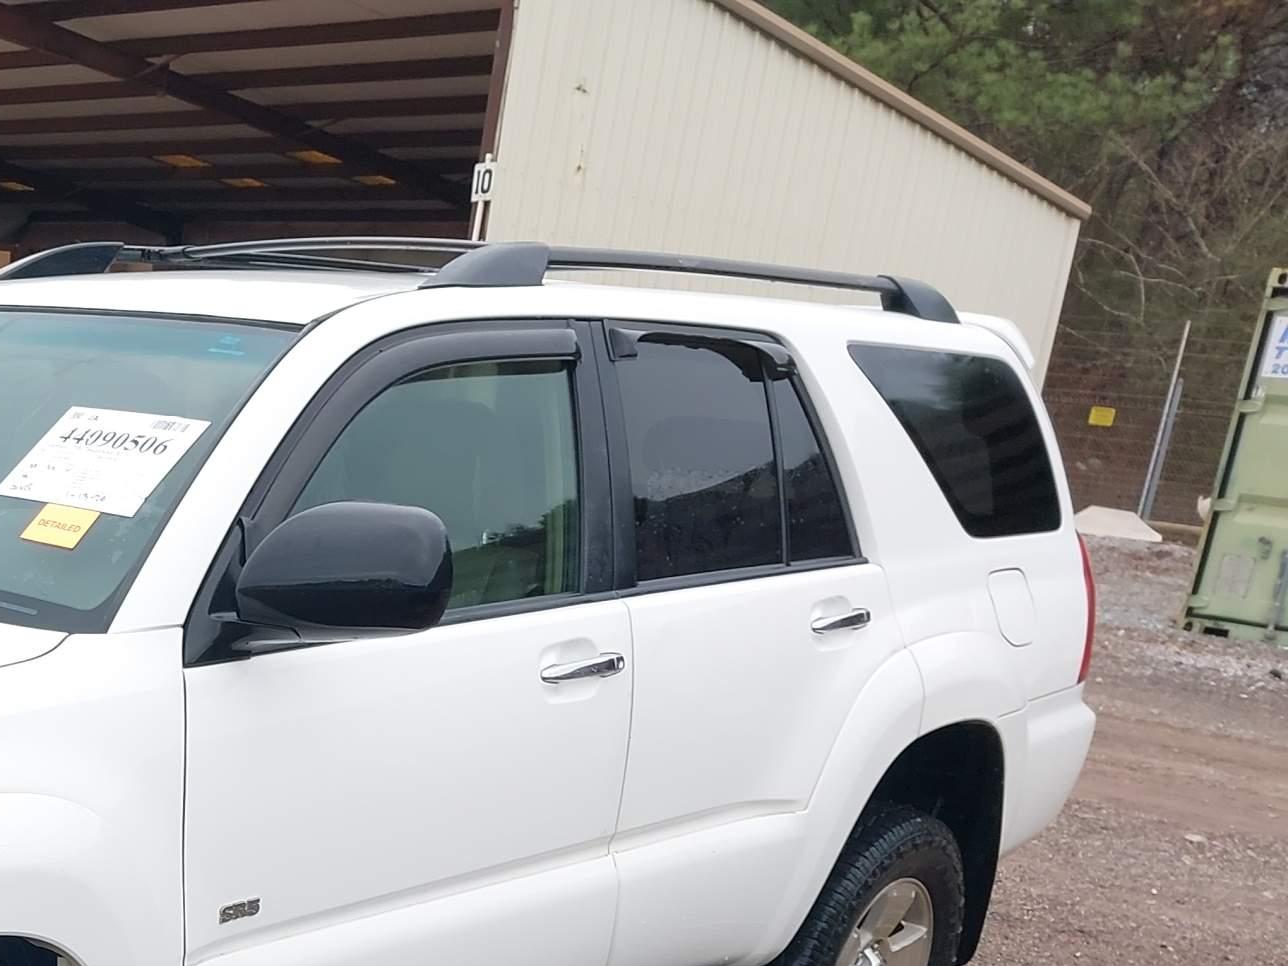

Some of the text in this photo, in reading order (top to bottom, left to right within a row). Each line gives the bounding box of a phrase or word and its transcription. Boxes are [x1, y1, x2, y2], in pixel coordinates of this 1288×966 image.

[475, 169, 493, 195] 10
[59, 427, 174, 456] 44090506
[37, 518, 81, 534] DETAILED
